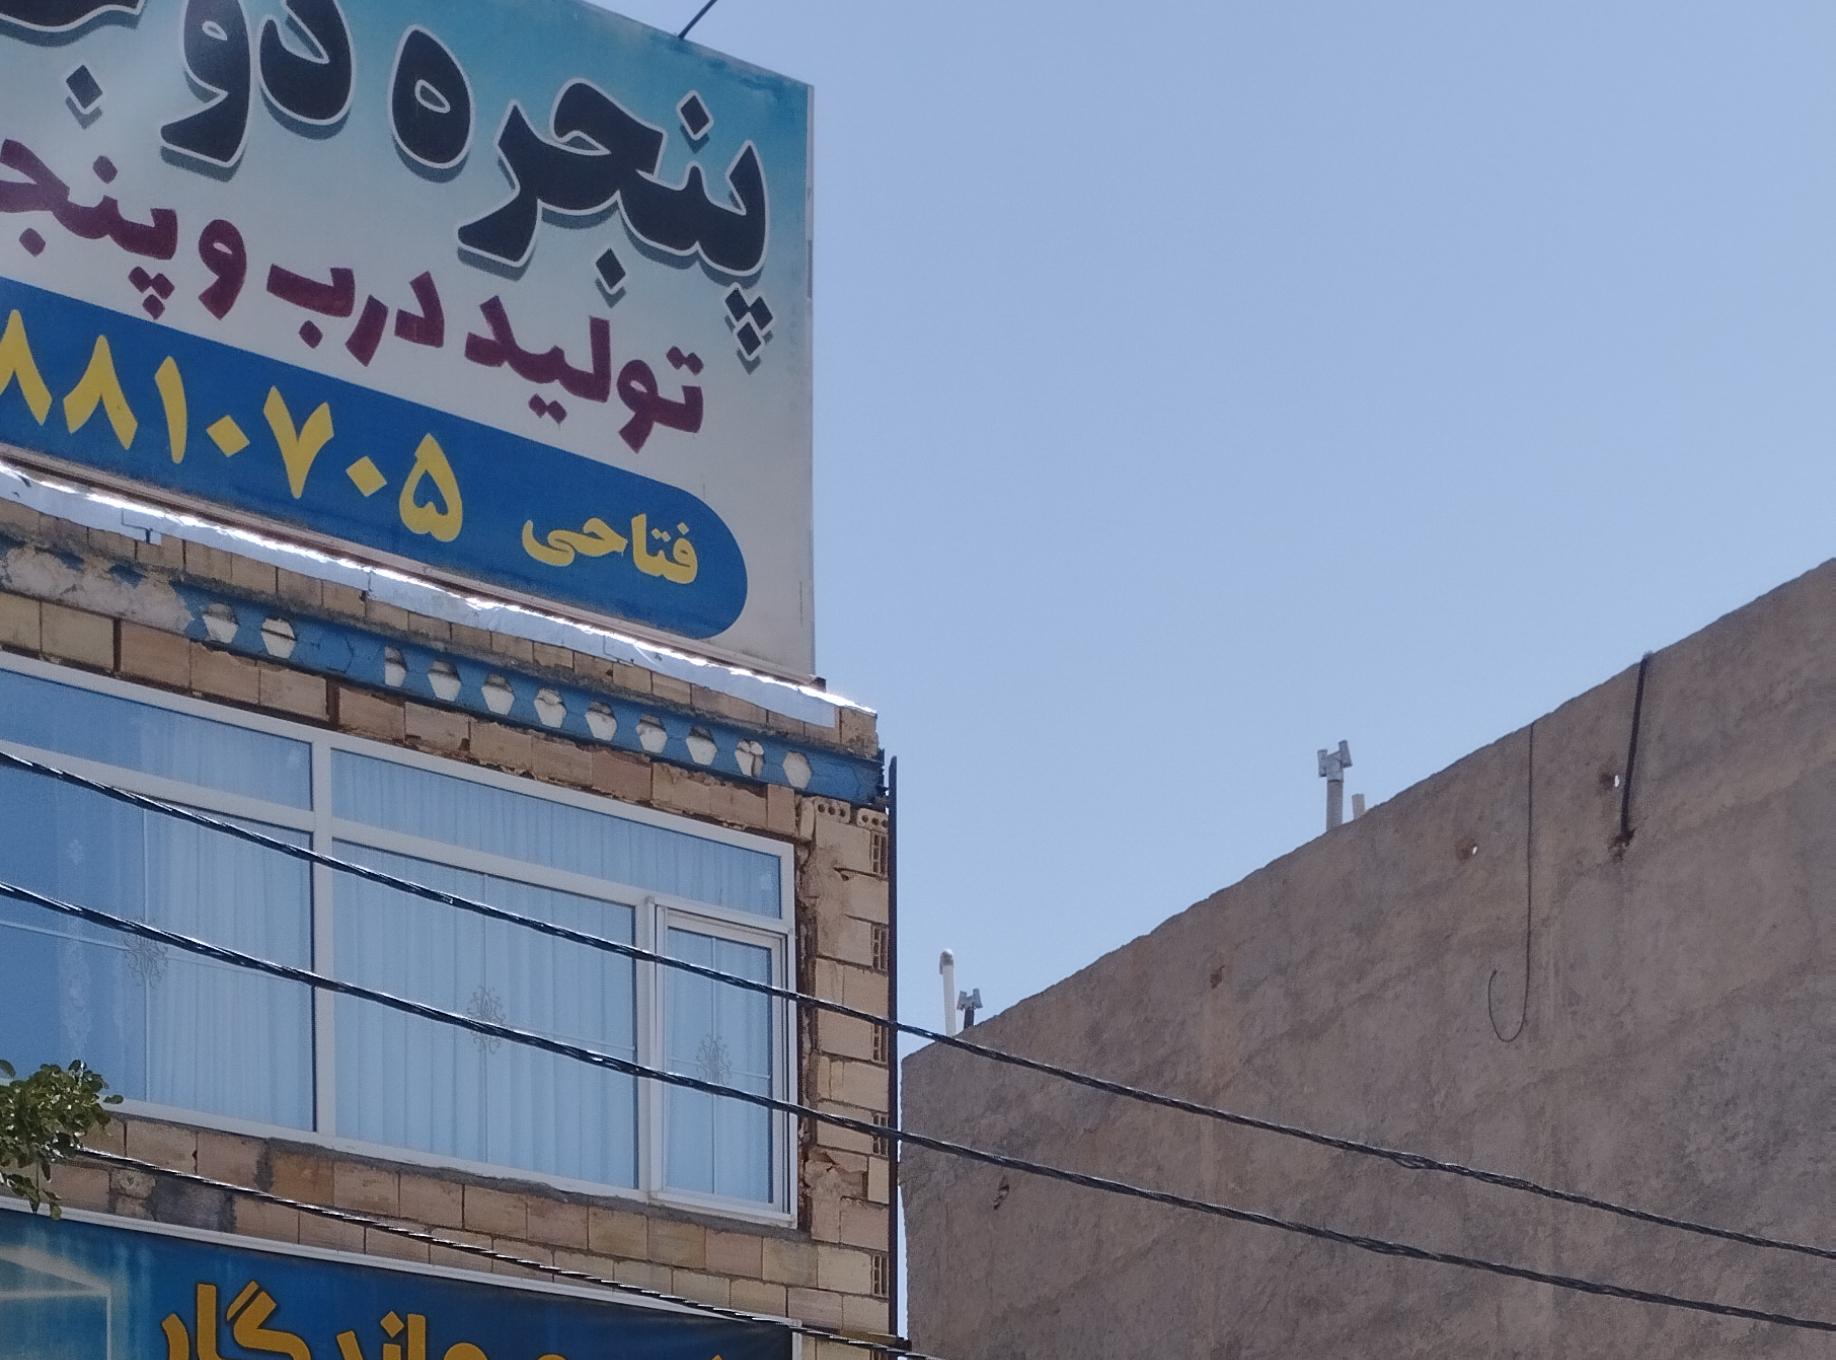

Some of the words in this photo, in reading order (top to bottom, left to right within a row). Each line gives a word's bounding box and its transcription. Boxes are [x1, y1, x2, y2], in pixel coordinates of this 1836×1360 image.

[389, 25, 774, 361] پنجره
[199, 219, 247, 320] و
[267, 263, 444, 367] درب
[465, 295, 704, 453] تولید
[522, 512, 699, 585] فتاحی
